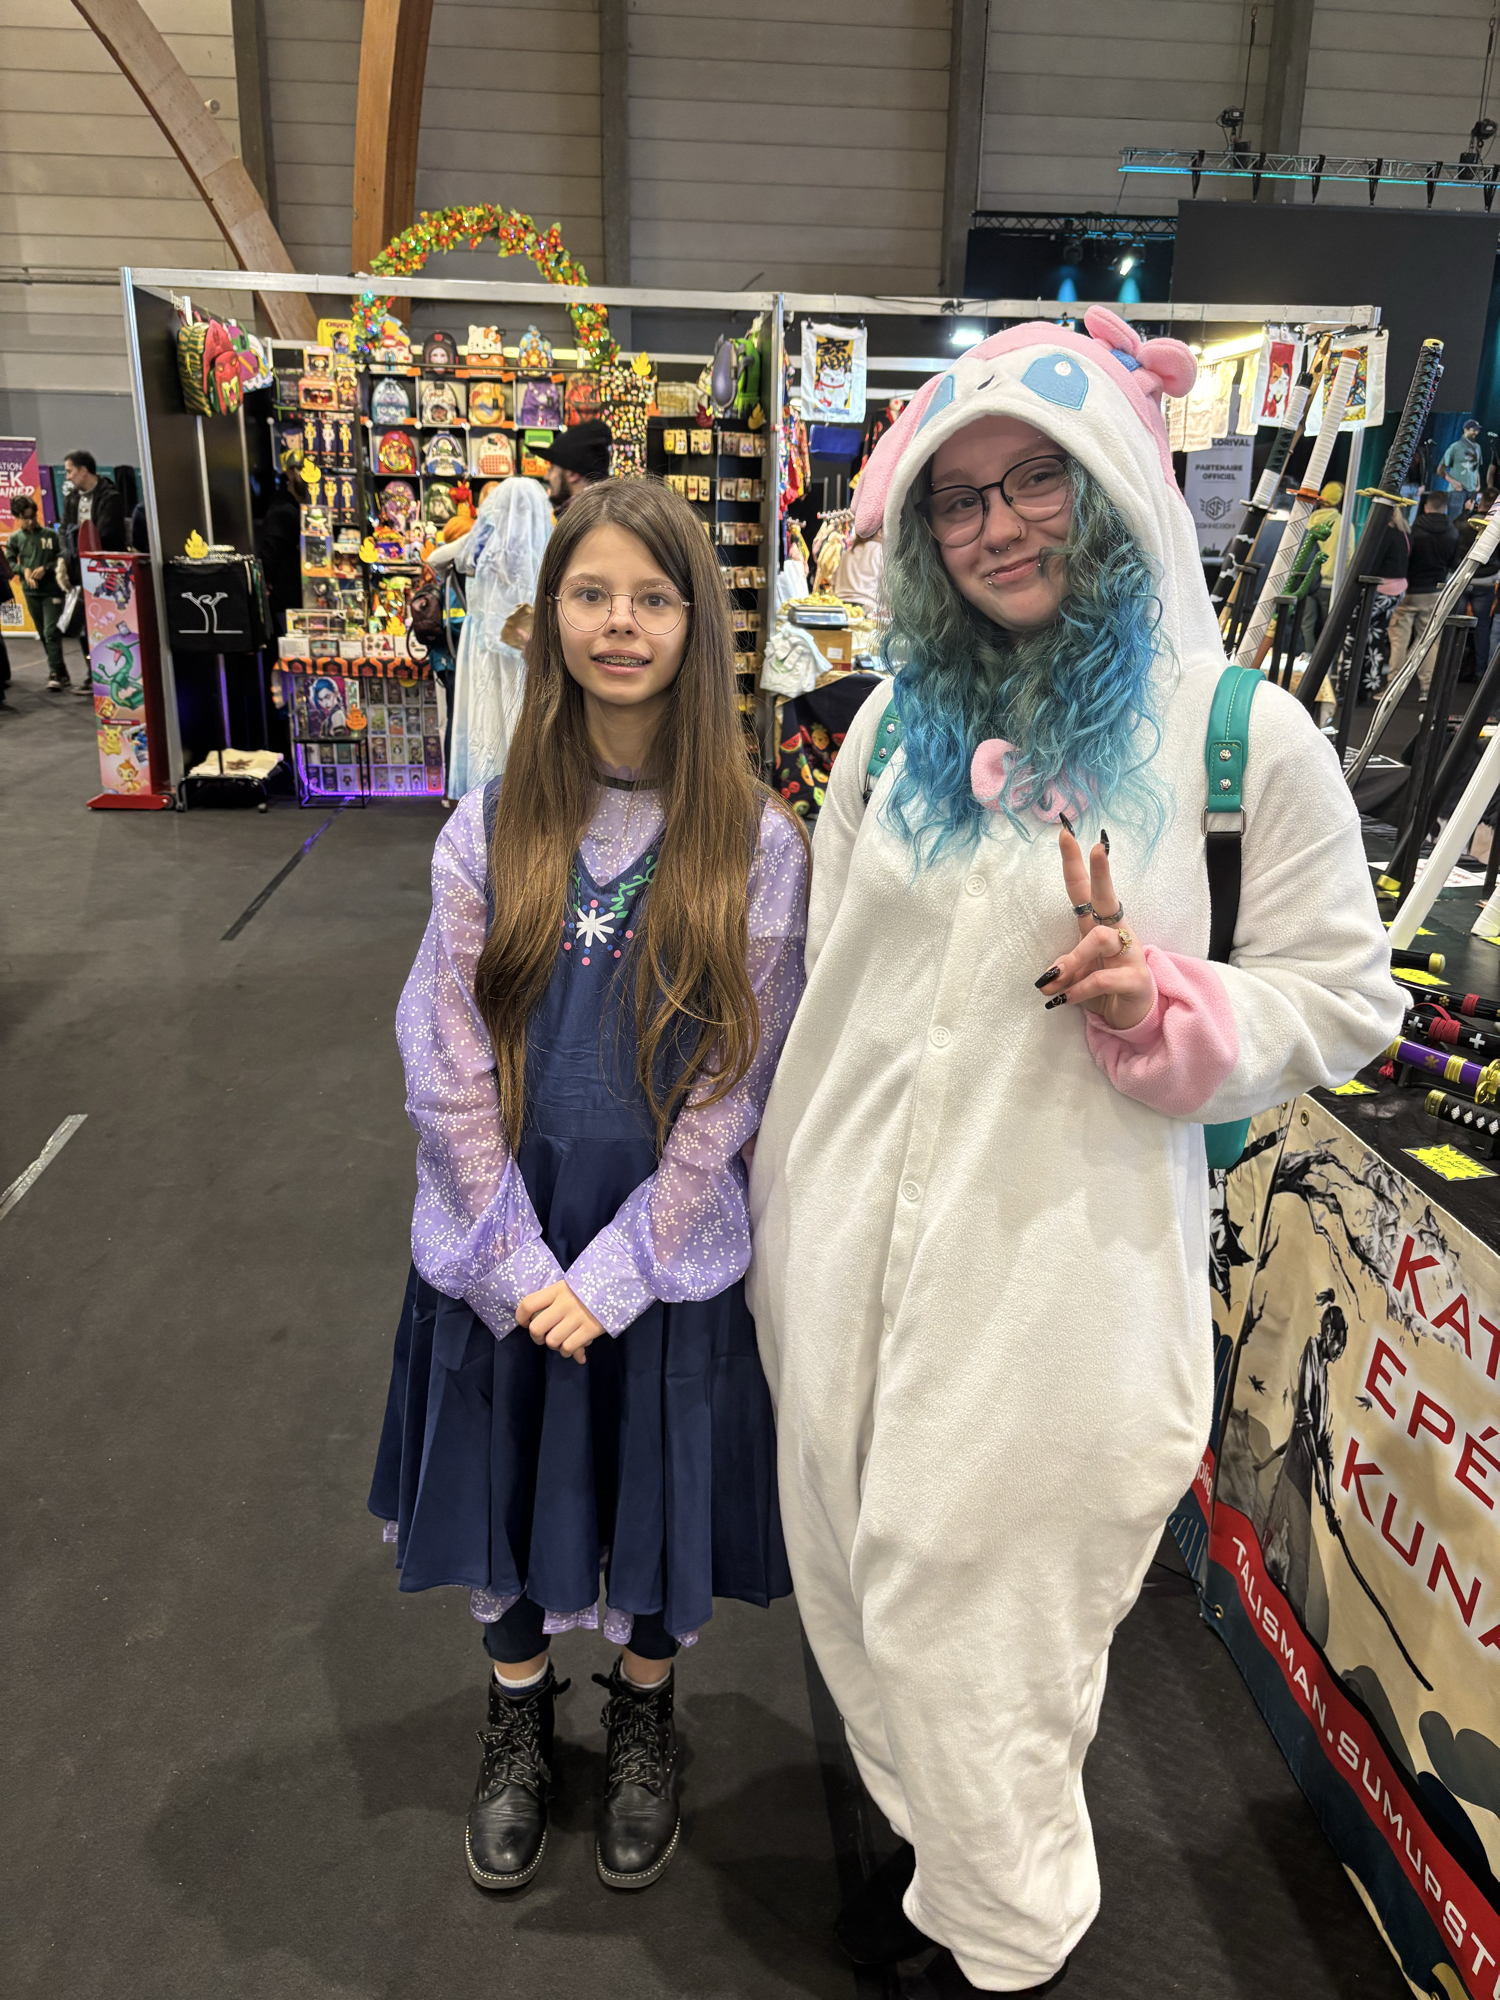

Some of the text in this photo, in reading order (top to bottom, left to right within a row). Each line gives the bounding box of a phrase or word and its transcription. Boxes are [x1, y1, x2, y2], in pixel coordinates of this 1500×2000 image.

[1195, 463, 1243, 471] PARTENAIRE
[1202, 472, 1237, 480] OFFICIEL
[1365, 1337, 1500, 1511] EPÉ
